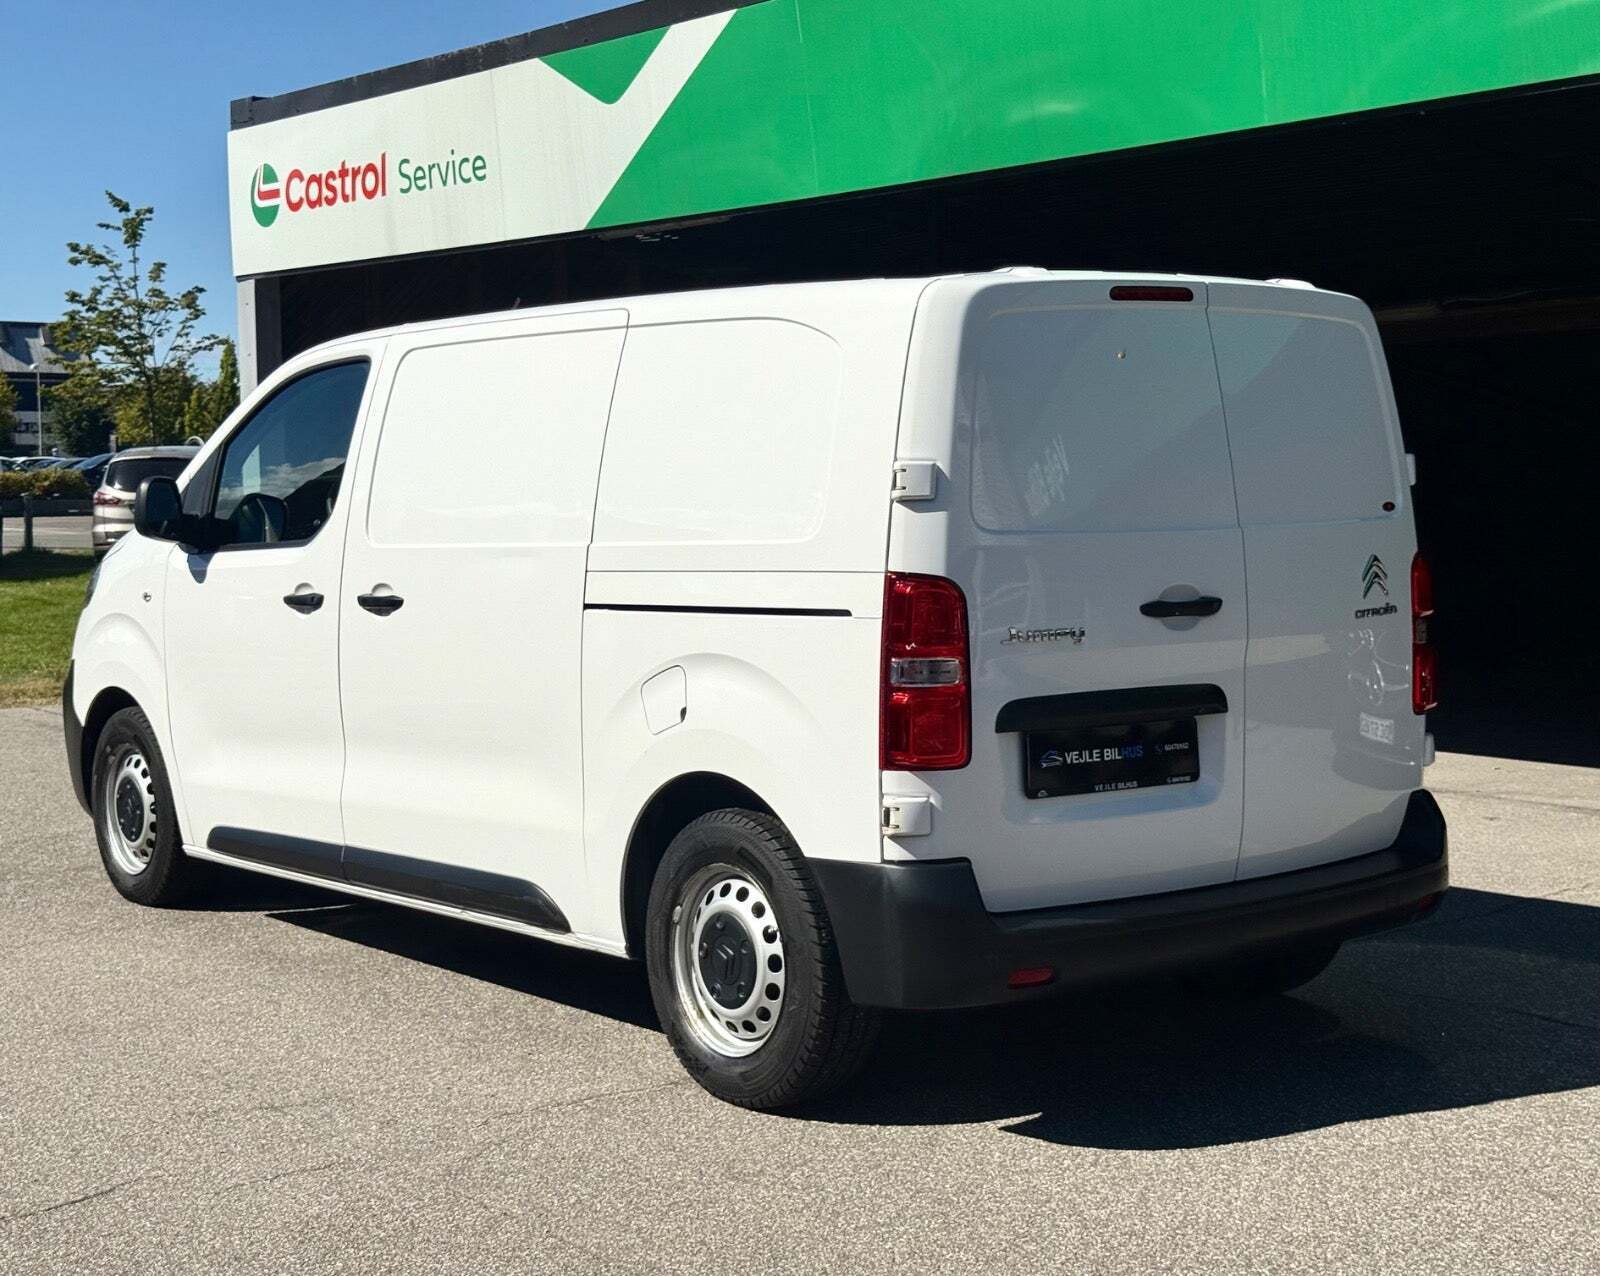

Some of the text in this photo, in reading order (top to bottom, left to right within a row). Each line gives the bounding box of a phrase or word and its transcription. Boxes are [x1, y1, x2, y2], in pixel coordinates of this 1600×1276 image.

[285, 148, 488, 213] Castrol Service
[1064, 744, 1144, 764] VEJLE BILHUS
[1094, 783, 1116, 792] VEJLE
